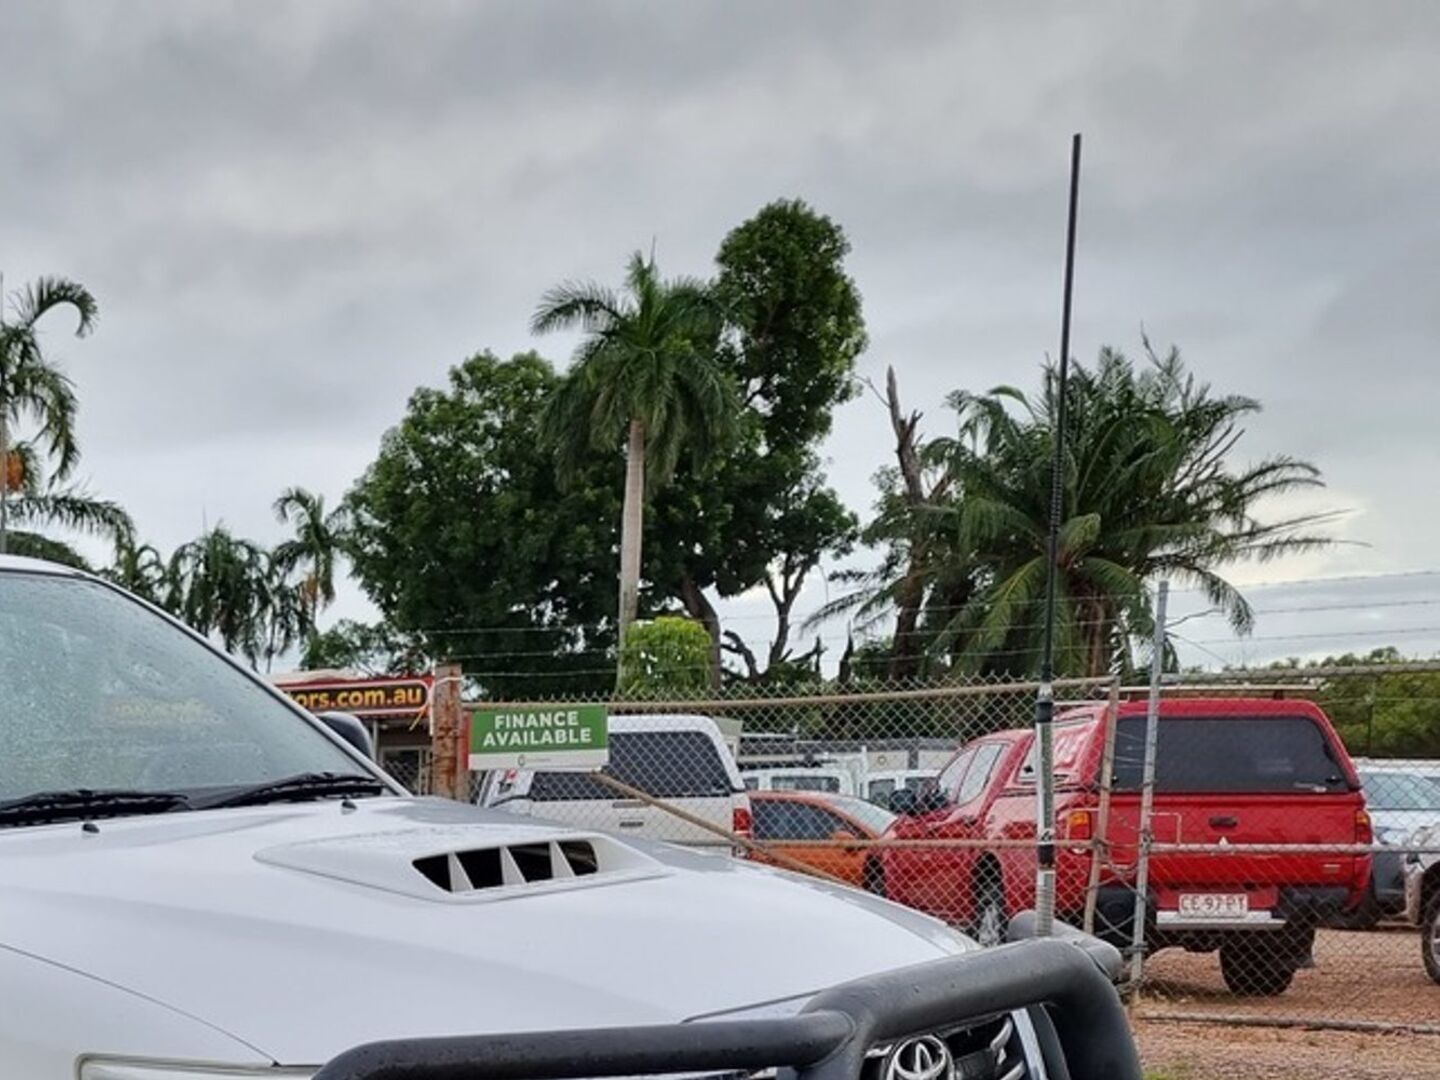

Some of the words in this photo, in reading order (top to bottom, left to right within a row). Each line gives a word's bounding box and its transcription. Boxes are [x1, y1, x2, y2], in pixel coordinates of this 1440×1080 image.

[290, 687, 422, 707] ors.com.au
[494, 711, 579, 729] FINANCE
[483, 728, 592, 746] AVAILABLE
